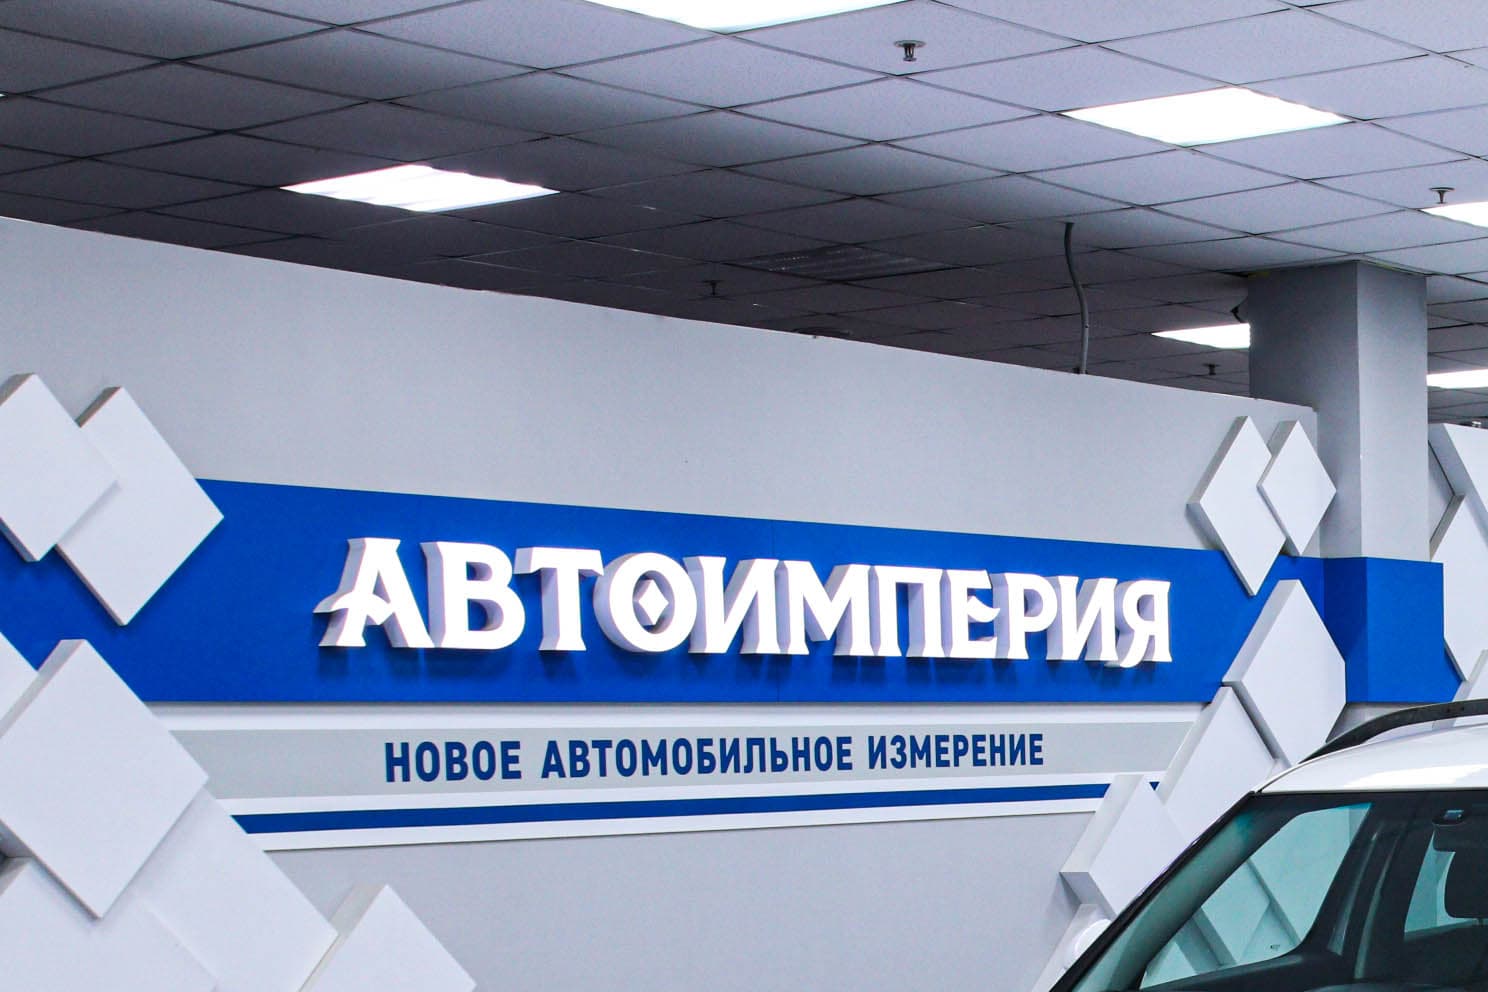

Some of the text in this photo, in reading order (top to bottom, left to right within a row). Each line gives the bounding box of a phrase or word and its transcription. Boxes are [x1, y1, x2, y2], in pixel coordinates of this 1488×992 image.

[313, 537, 1172, 667] АВТОИМПЕРИЯ
[385, 733, 1044, 782] НОВОЕ АВТОМОБИЛЬНОЕ ИЗМЕРЕНИЕ
